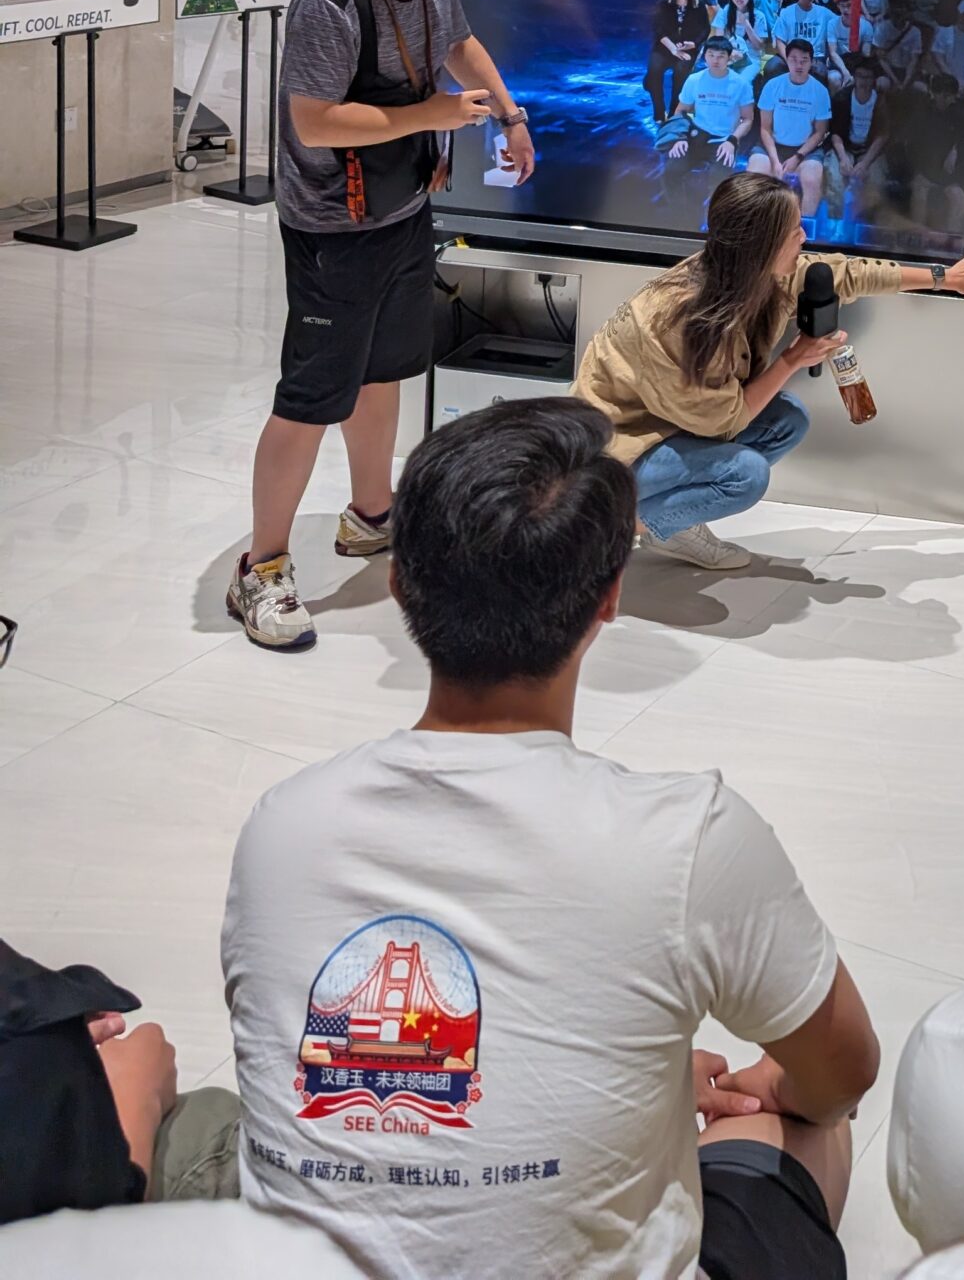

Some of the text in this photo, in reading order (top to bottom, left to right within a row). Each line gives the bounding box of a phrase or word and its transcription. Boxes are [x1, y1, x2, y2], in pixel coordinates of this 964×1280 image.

[25, 16, 63, 32] COOL.
[67, 9, 112, 27] REPEAT.
[320, 1067, 451, 1091] 汉香玉·未来领袖团
[343, 1116, 430, 1135] SEE China
